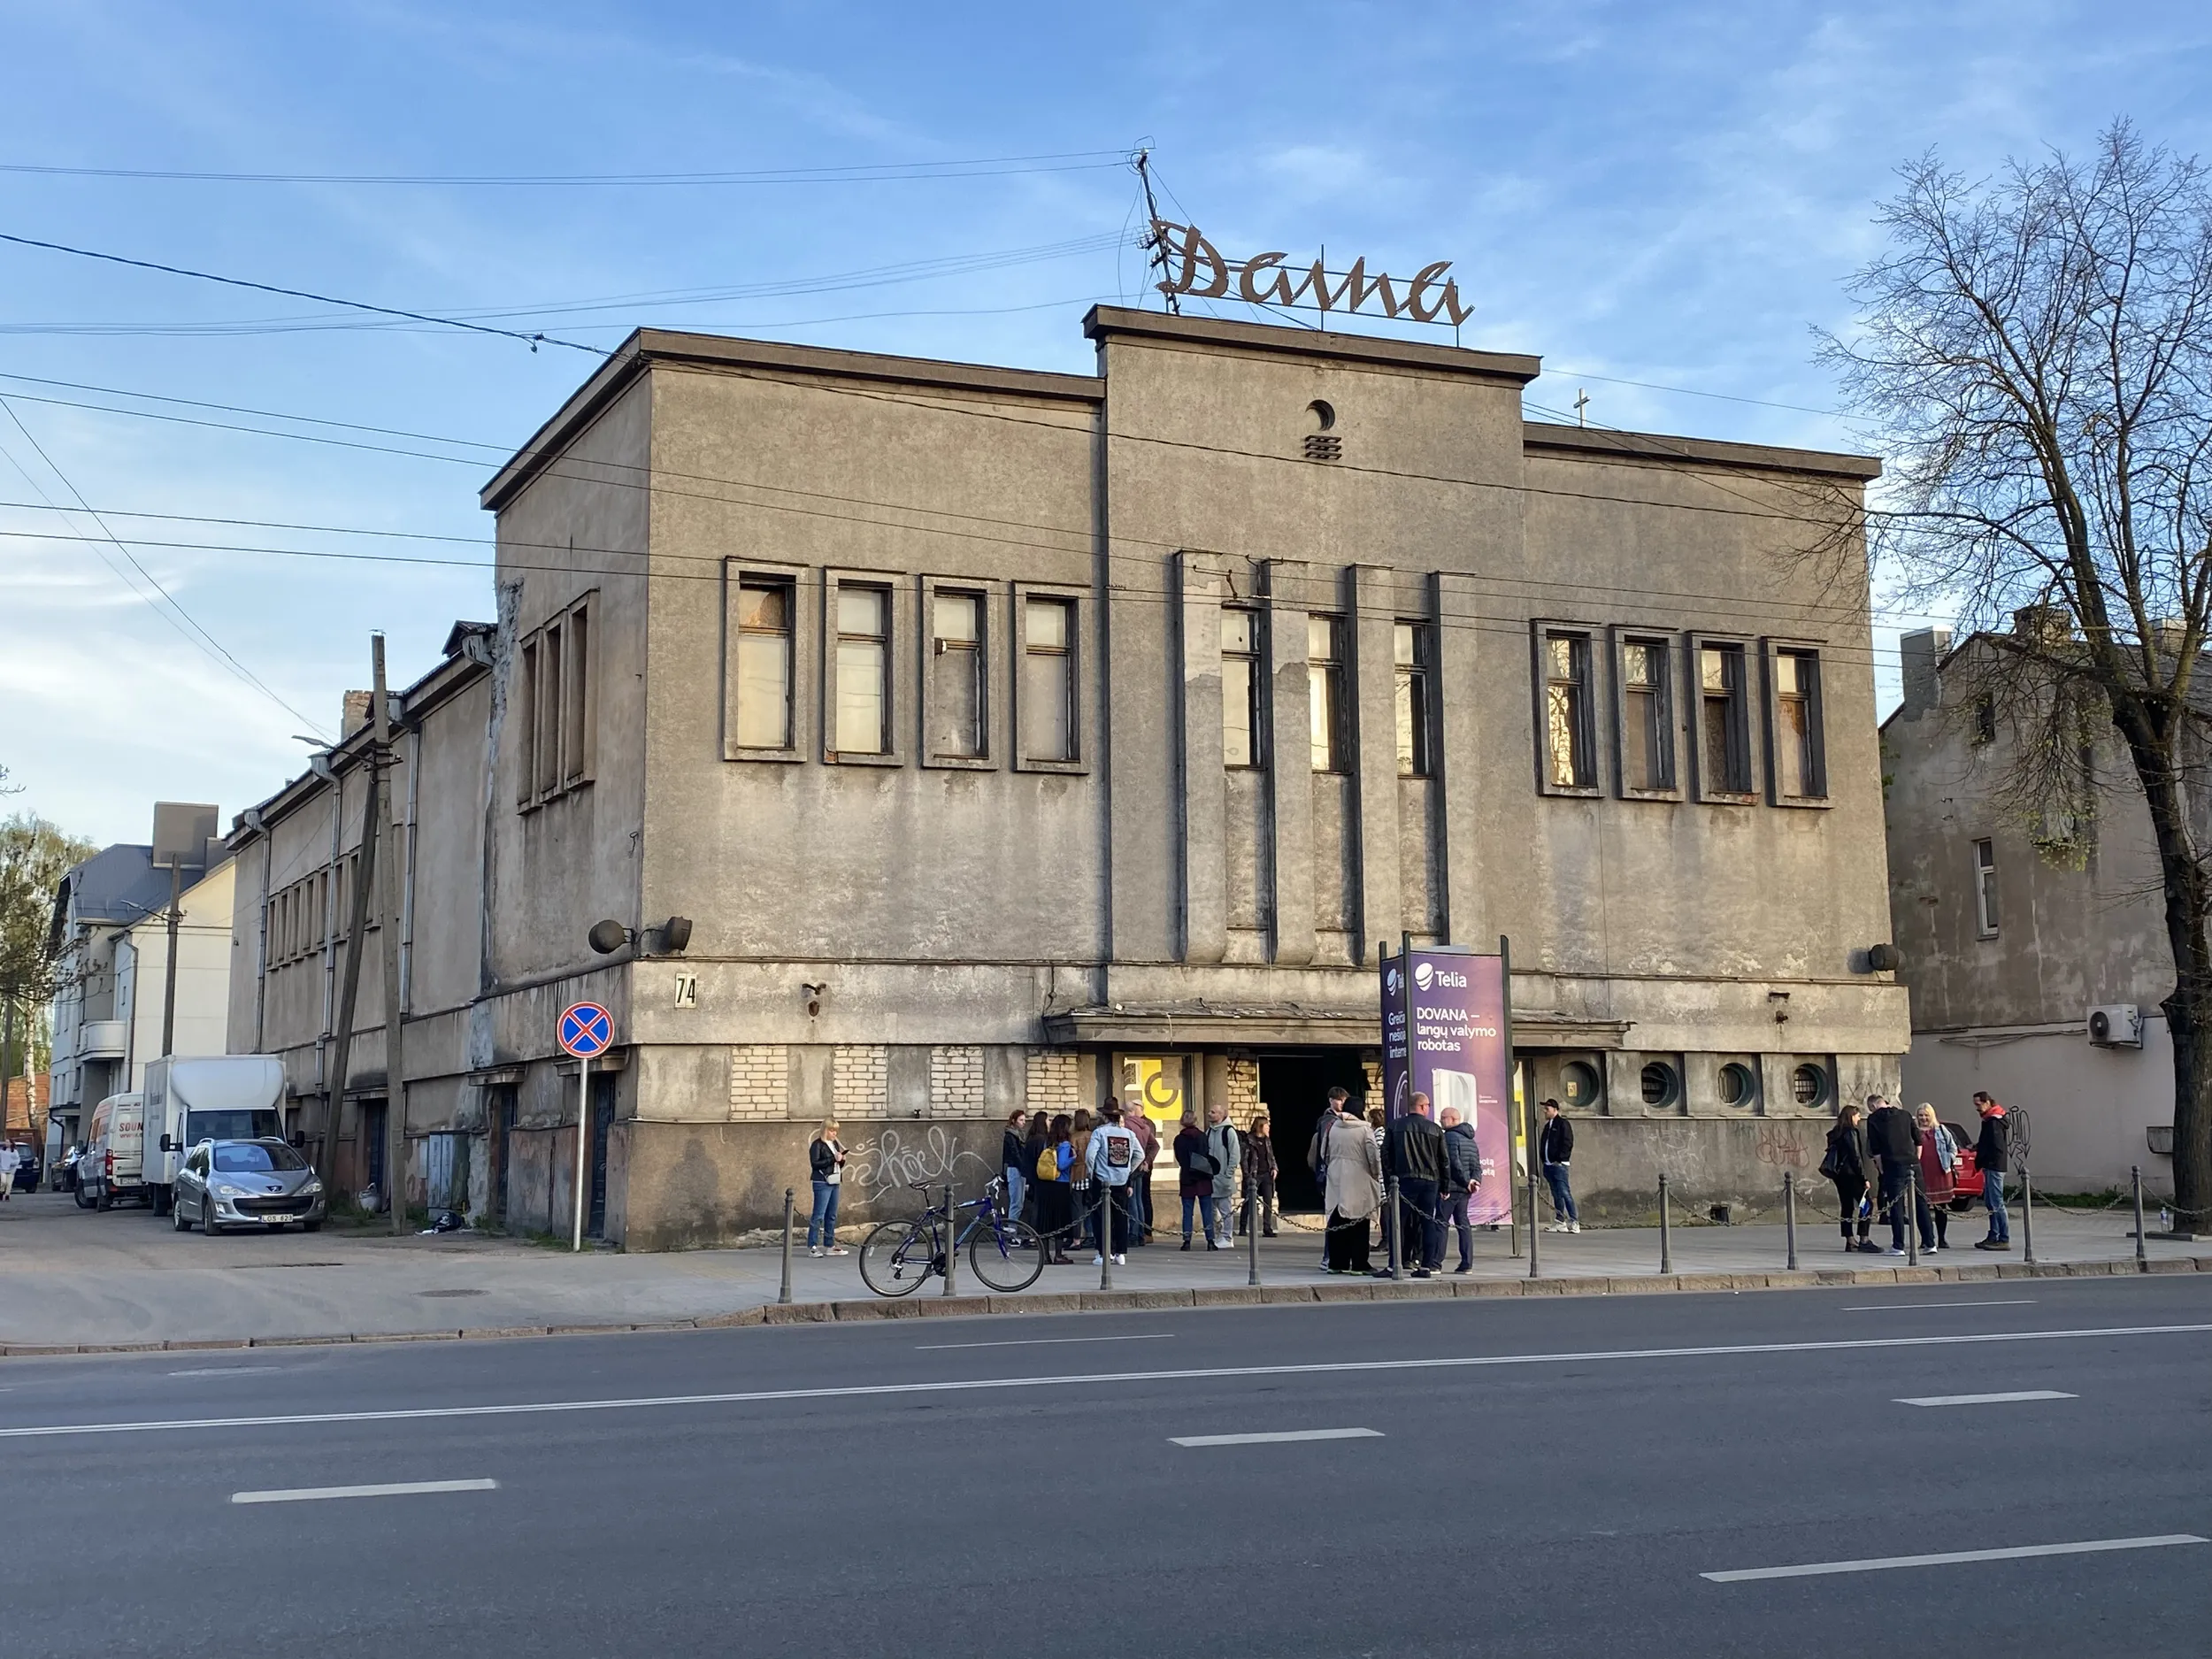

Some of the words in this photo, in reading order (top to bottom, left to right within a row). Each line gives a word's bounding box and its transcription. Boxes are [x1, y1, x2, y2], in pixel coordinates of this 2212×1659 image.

[1435, 971, 1467, 987] Telia
[676, 978, 695, 1003] 74
[1417, 1007, 1469, 1021] DOVANA
[1417, 1022, 1448, 1039] langų
[1450, 1025, 1497, 1040] valymo
[1417, 1038, 1462, 1052] robotas
